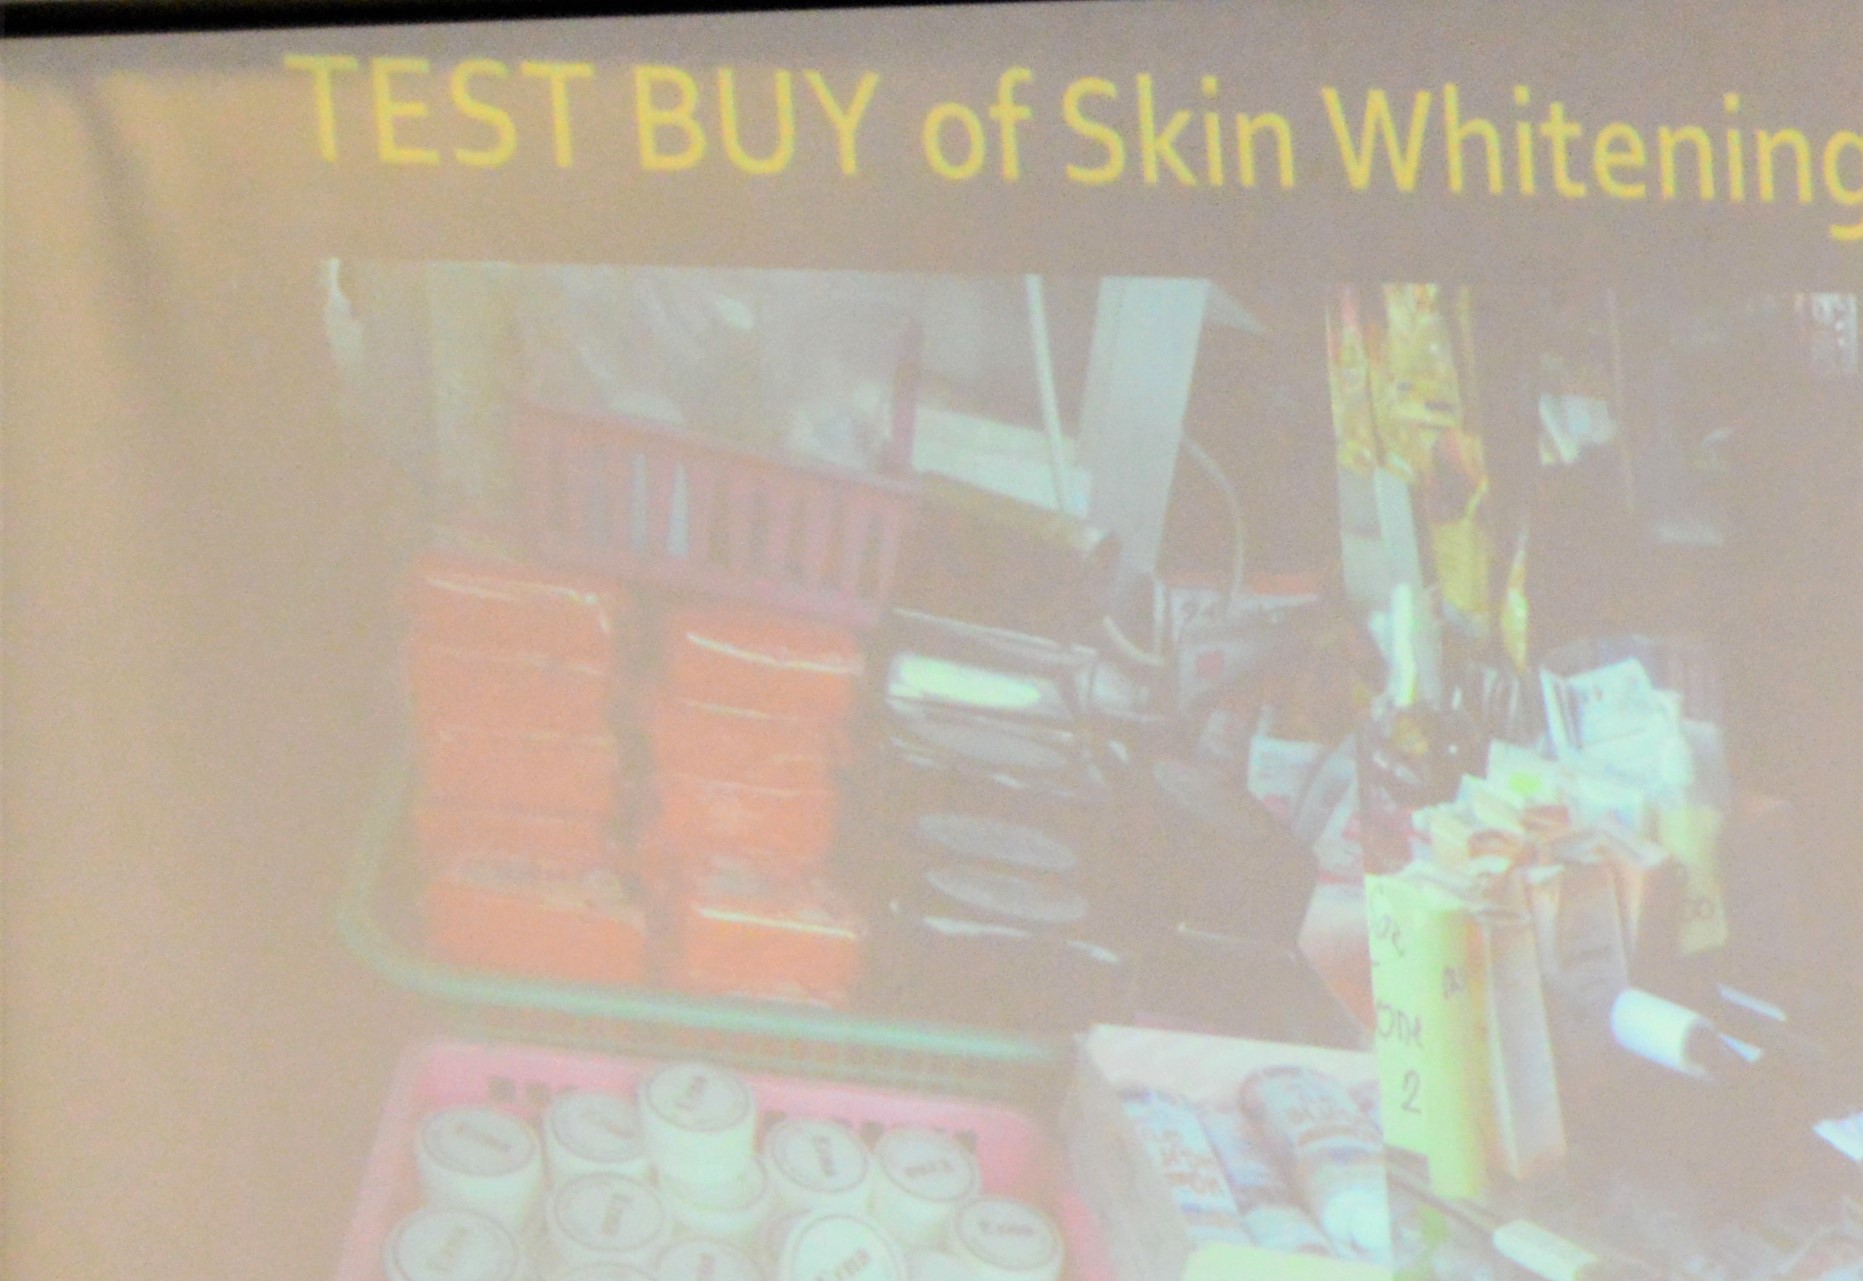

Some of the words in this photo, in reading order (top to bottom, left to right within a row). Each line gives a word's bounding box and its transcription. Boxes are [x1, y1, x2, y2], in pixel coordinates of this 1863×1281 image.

[284, 53, 594, 168] TEST
[632, 65, 879, 177] BUY
[922, 67, 1032, 182] of
[1062, 72, 1295, 188] Skin
